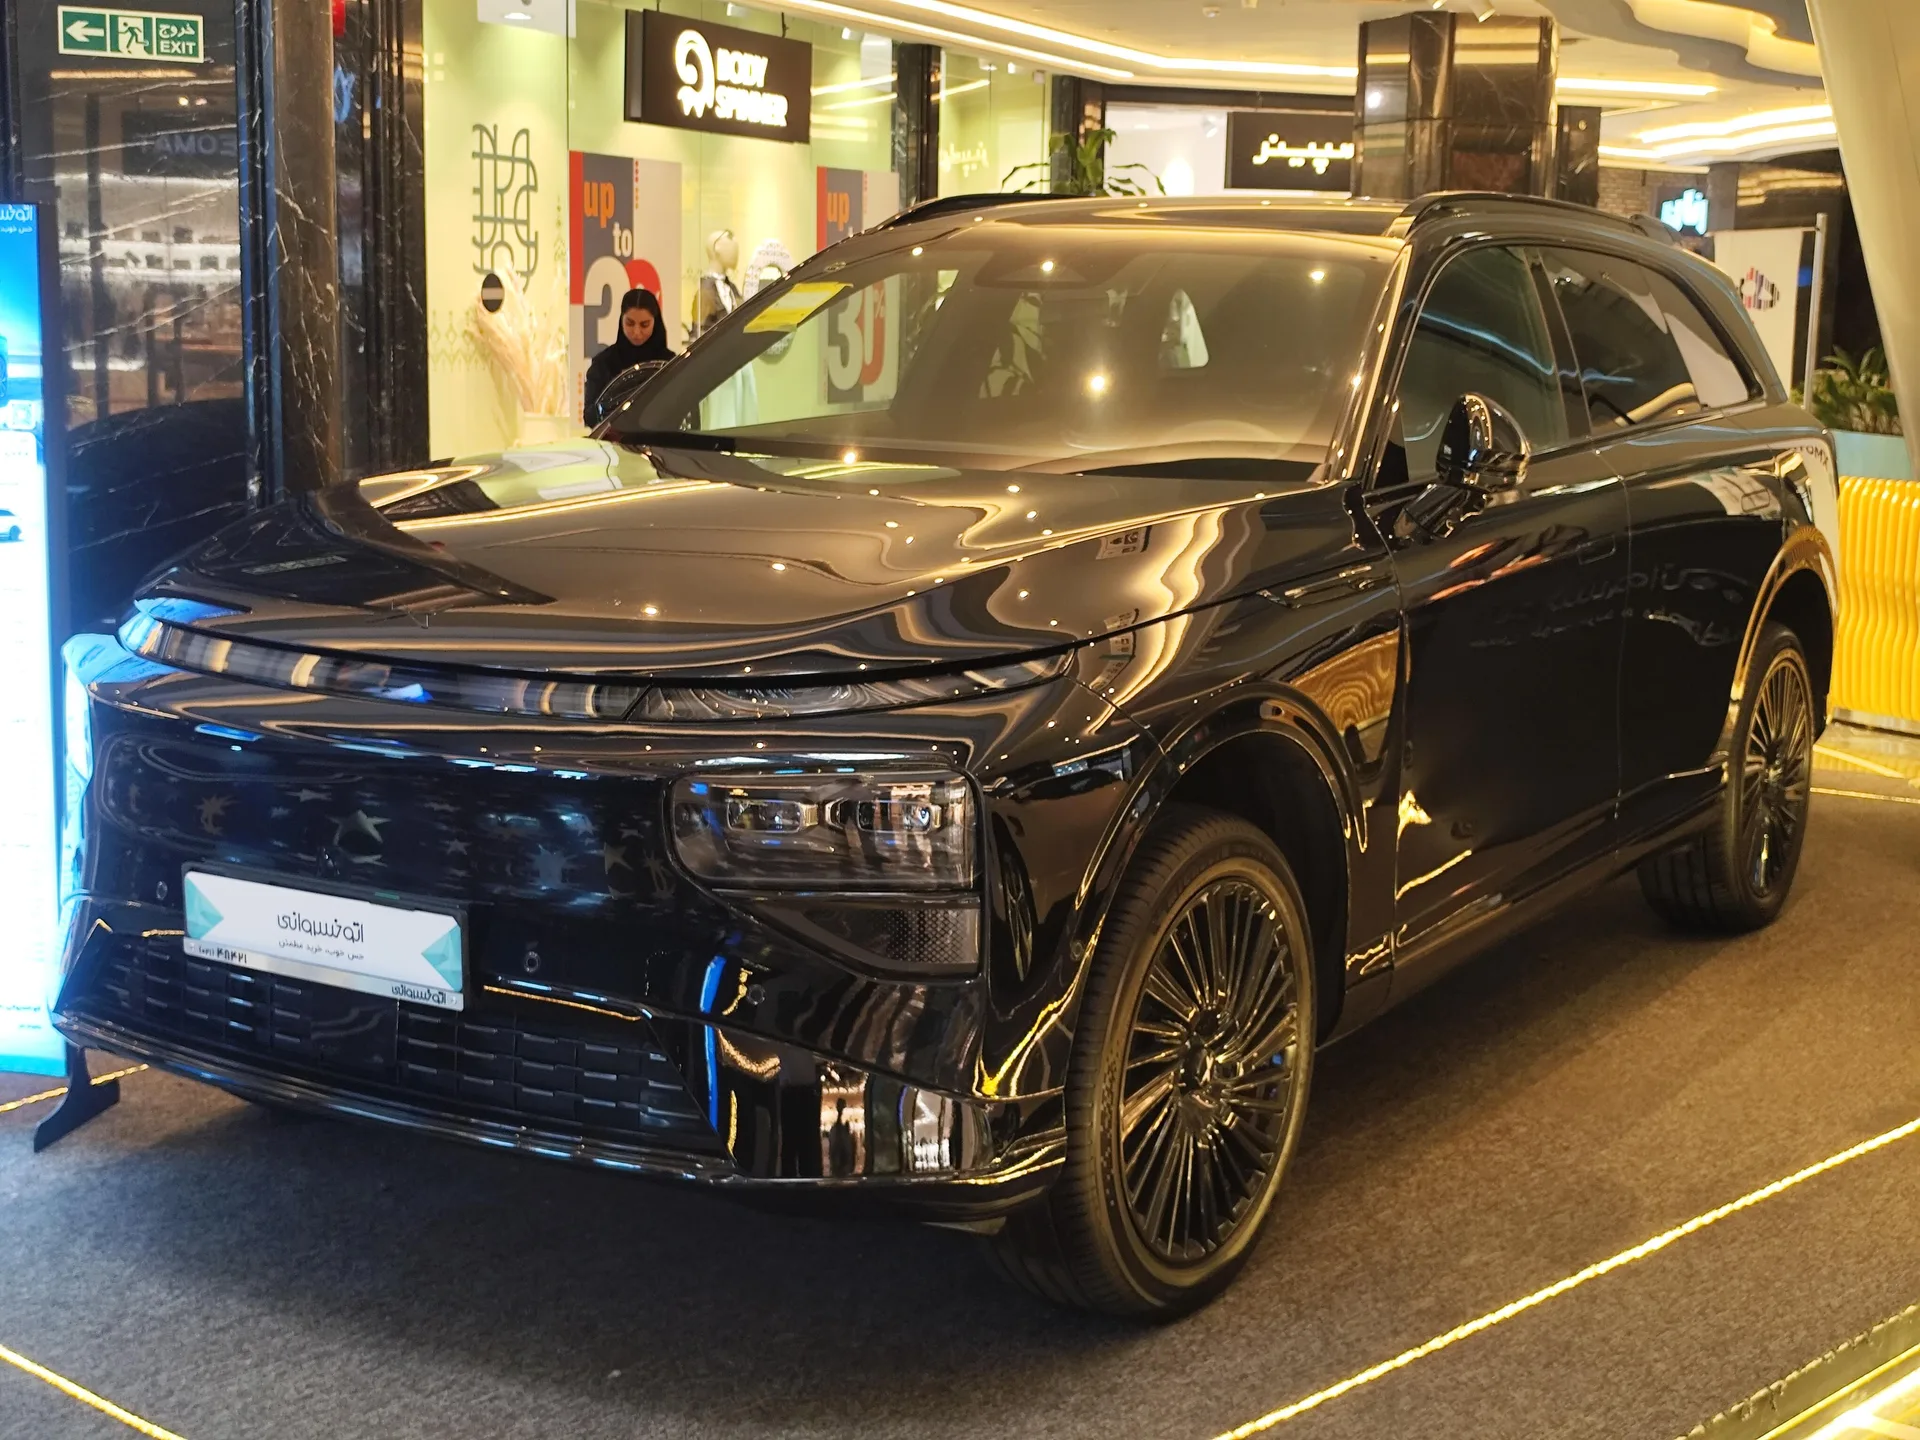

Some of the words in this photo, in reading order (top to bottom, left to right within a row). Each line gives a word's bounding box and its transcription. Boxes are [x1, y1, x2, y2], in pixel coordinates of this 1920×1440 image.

[158, 22, 196, 39] خروج
[160, 41, 196, 55] EXIT
[716, 47, 769, 89] BODY
[714, 84, 788, 127] SPINNER
[584, 181, 615, 228] up
[827, 192, 849, 231] up
[612, 222, 633, 257] to
